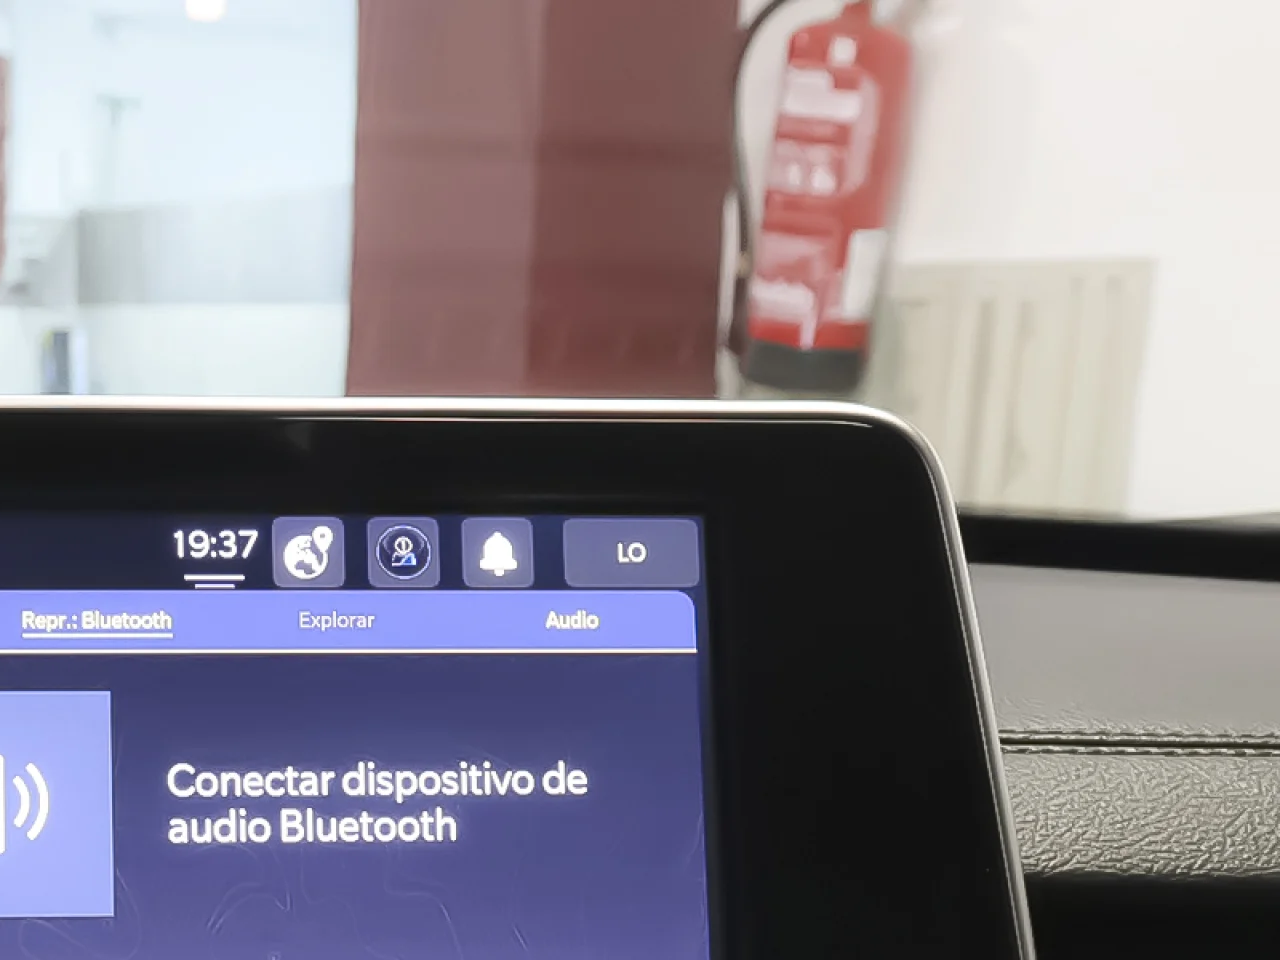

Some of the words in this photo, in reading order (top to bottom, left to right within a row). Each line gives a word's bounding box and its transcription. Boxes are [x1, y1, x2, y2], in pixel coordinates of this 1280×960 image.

[173, 529, 259, 560] 19:37
[617, 543, 647, 563] LO
[81, 610, 172, 630] Bluetooth
[299, 611, 375, 630] Explorar
[545, 611, 599, 630] Audio
[167, 763, 335, 798] Conectar
[342, 762, 534, 803] dispositivo
[542, 761, 588, 796] de
[168, 809, 272, 845] audio
[280, 808, 457, 843] Bluetooth
